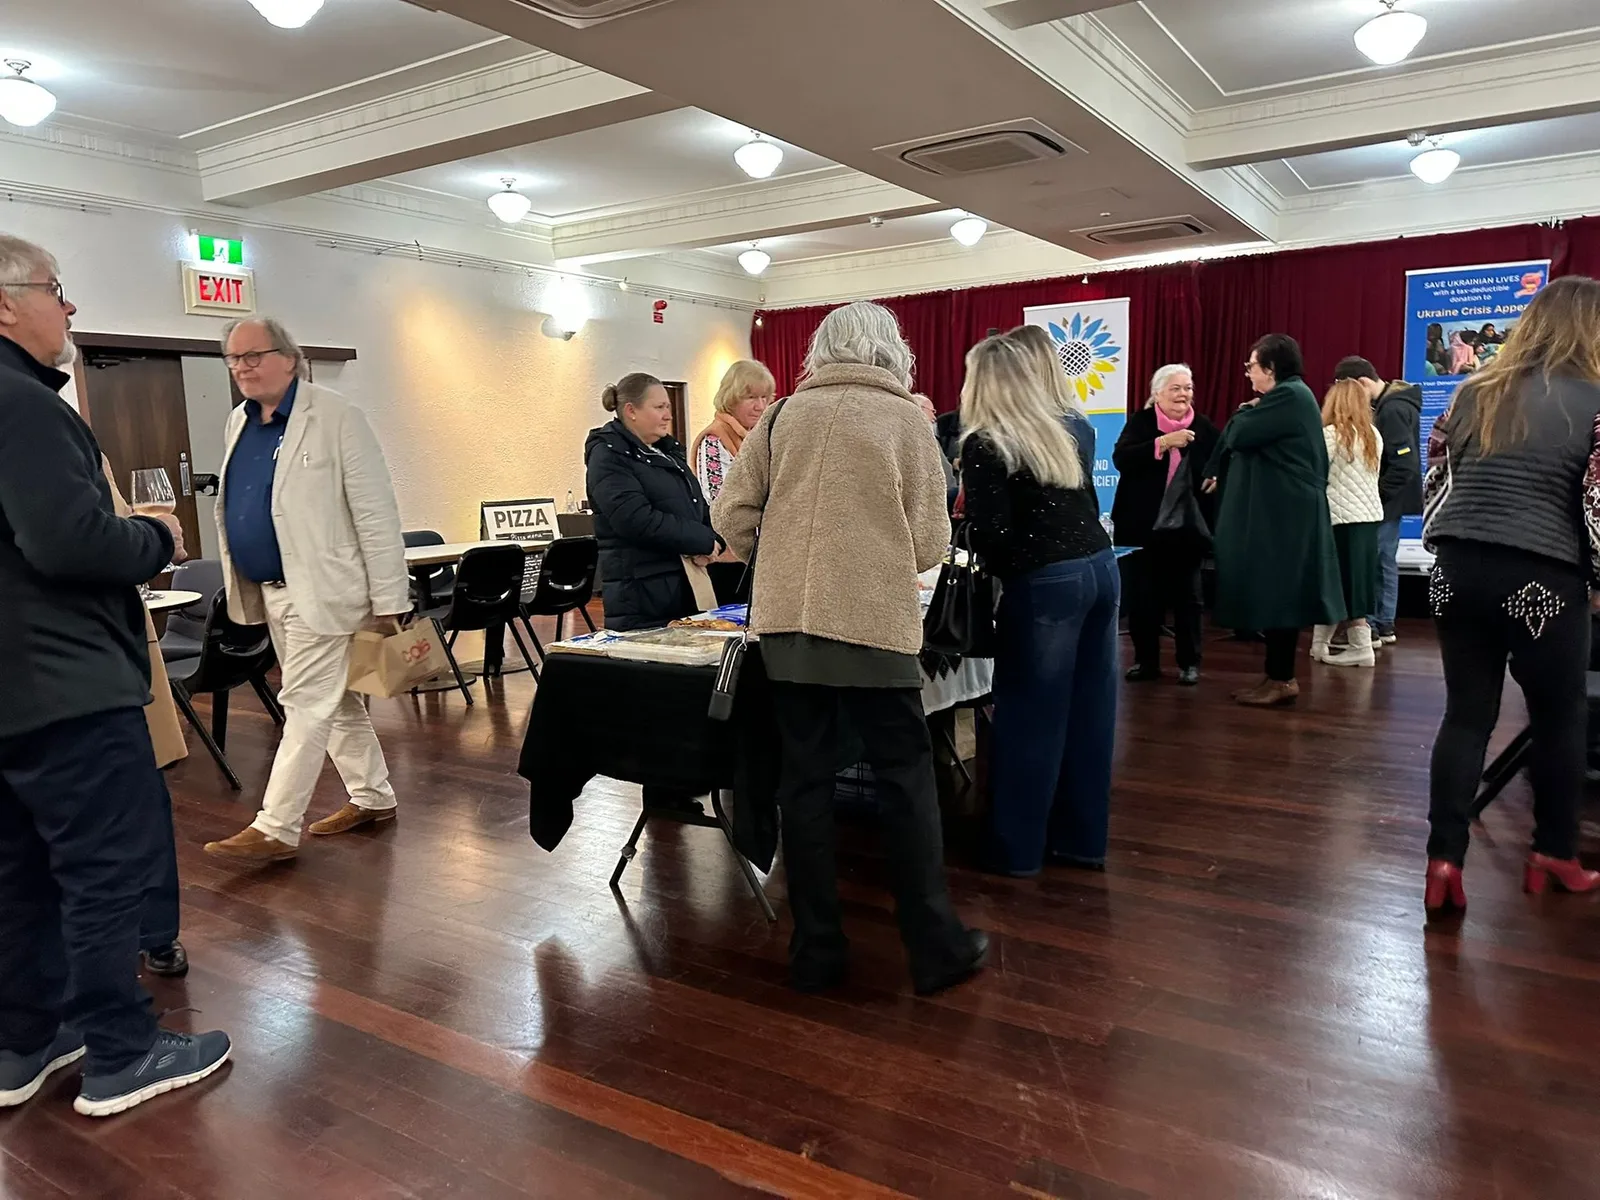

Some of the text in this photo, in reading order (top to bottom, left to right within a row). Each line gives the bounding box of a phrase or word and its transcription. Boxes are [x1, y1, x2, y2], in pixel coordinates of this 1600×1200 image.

[1424, 274, 1520, 289] SAVE UKRAINIAN LIVES
[199, 275, 243, 304] EXIT
[1456, 285, 1510, 295] tax-deductible
[1449, 295, 1482, 303] donation
[1417, 303, 1528, 319] Ukraine Crisis Appe
[1092, 475, 1119, 487] OCIETY
[493, 508, 549, 528] PIZZA
